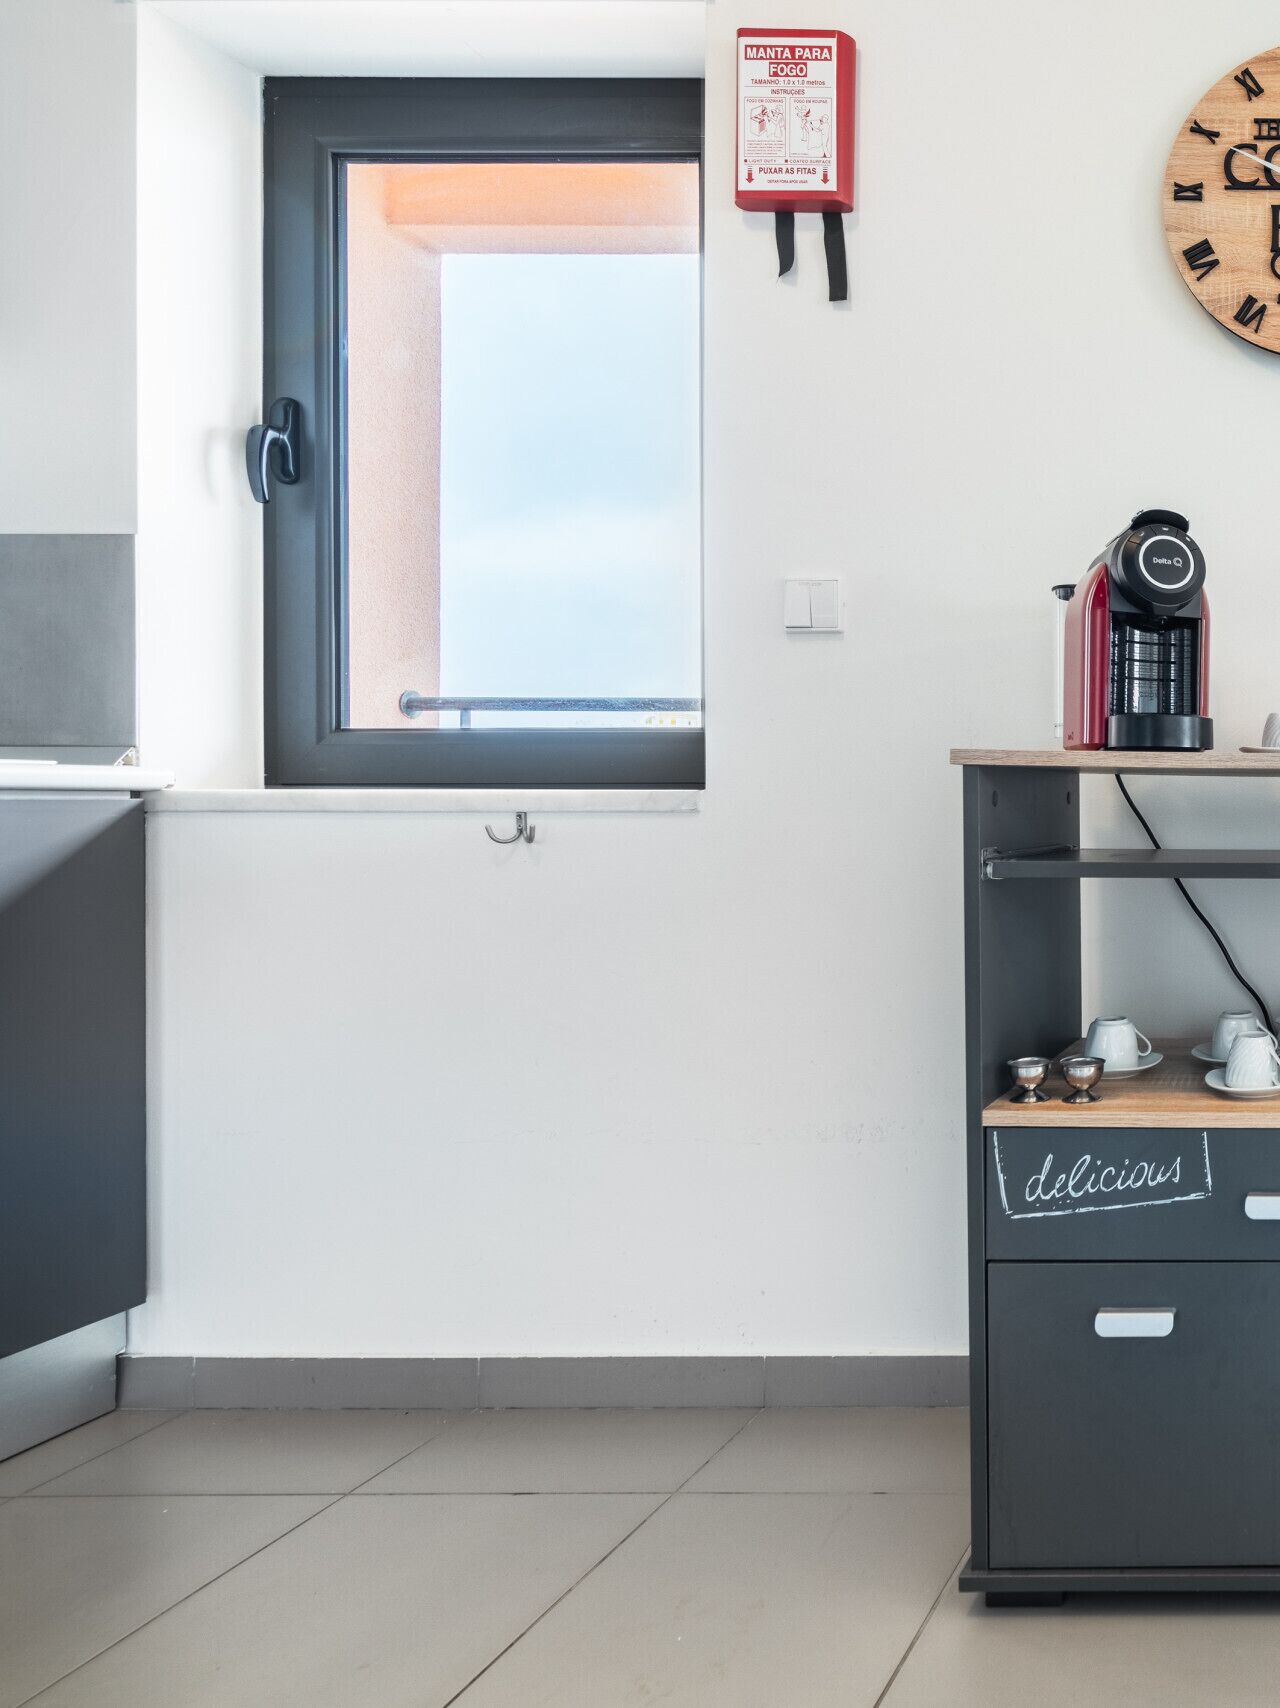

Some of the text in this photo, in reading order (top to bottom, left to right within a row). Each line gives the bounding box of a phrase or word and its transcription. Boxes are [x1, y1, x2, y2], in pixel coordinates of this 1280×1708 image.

[746, 47, 831, 60] MANTA PARA
[769, 63, 807, 77] FOGO
[758, 167, 817, 175] PUXAR AS FITAS
[1152, 556, 1183, 568] Delta Q
[1025, 1153, 1182, 1202] delicious
